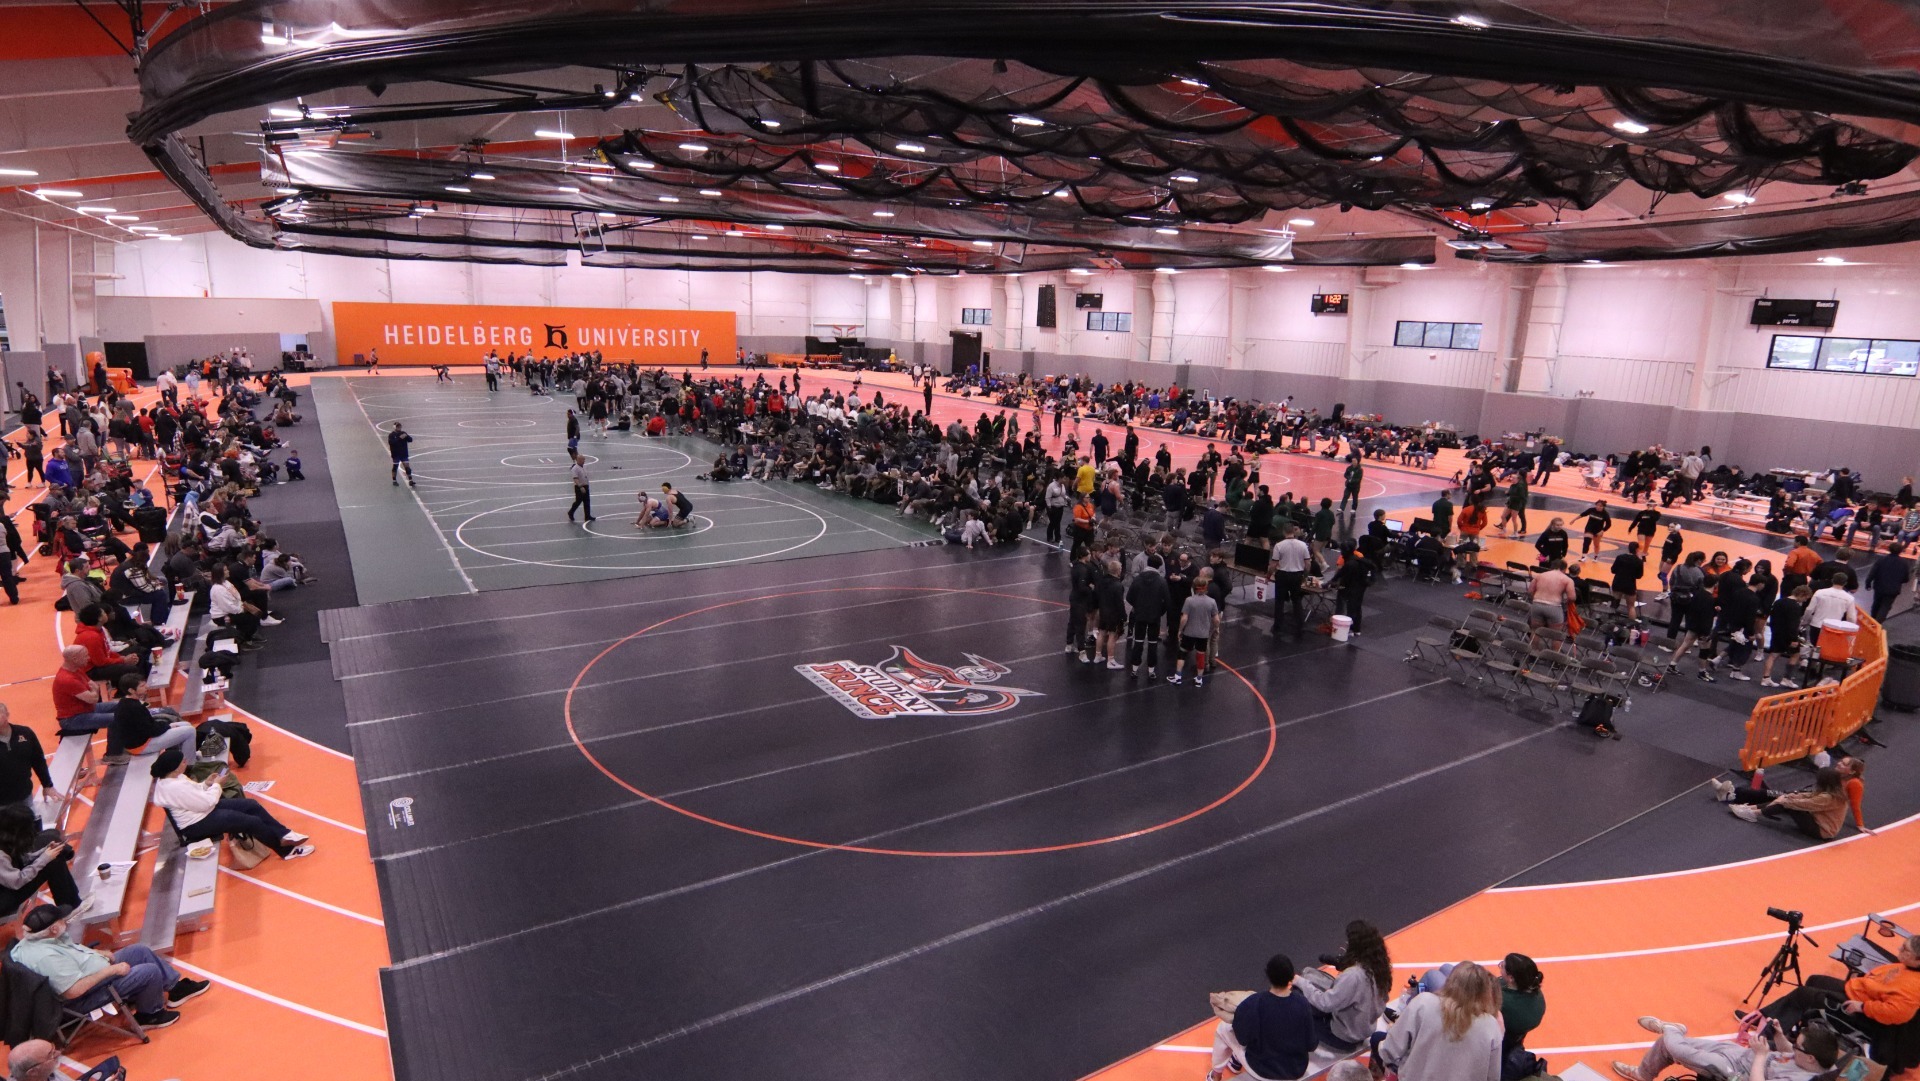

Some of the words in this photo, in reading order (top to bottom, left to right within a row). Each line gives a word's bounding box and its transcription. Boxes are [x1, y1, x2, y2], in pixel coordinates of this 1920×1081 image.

[384, 324, 533, 346] HEIDELBERG
[577, 327, 701, 347] UNIVERSITY
[809, 662, 907, 715] PRINCE
[849, 666, 939, 712] STUDENT
